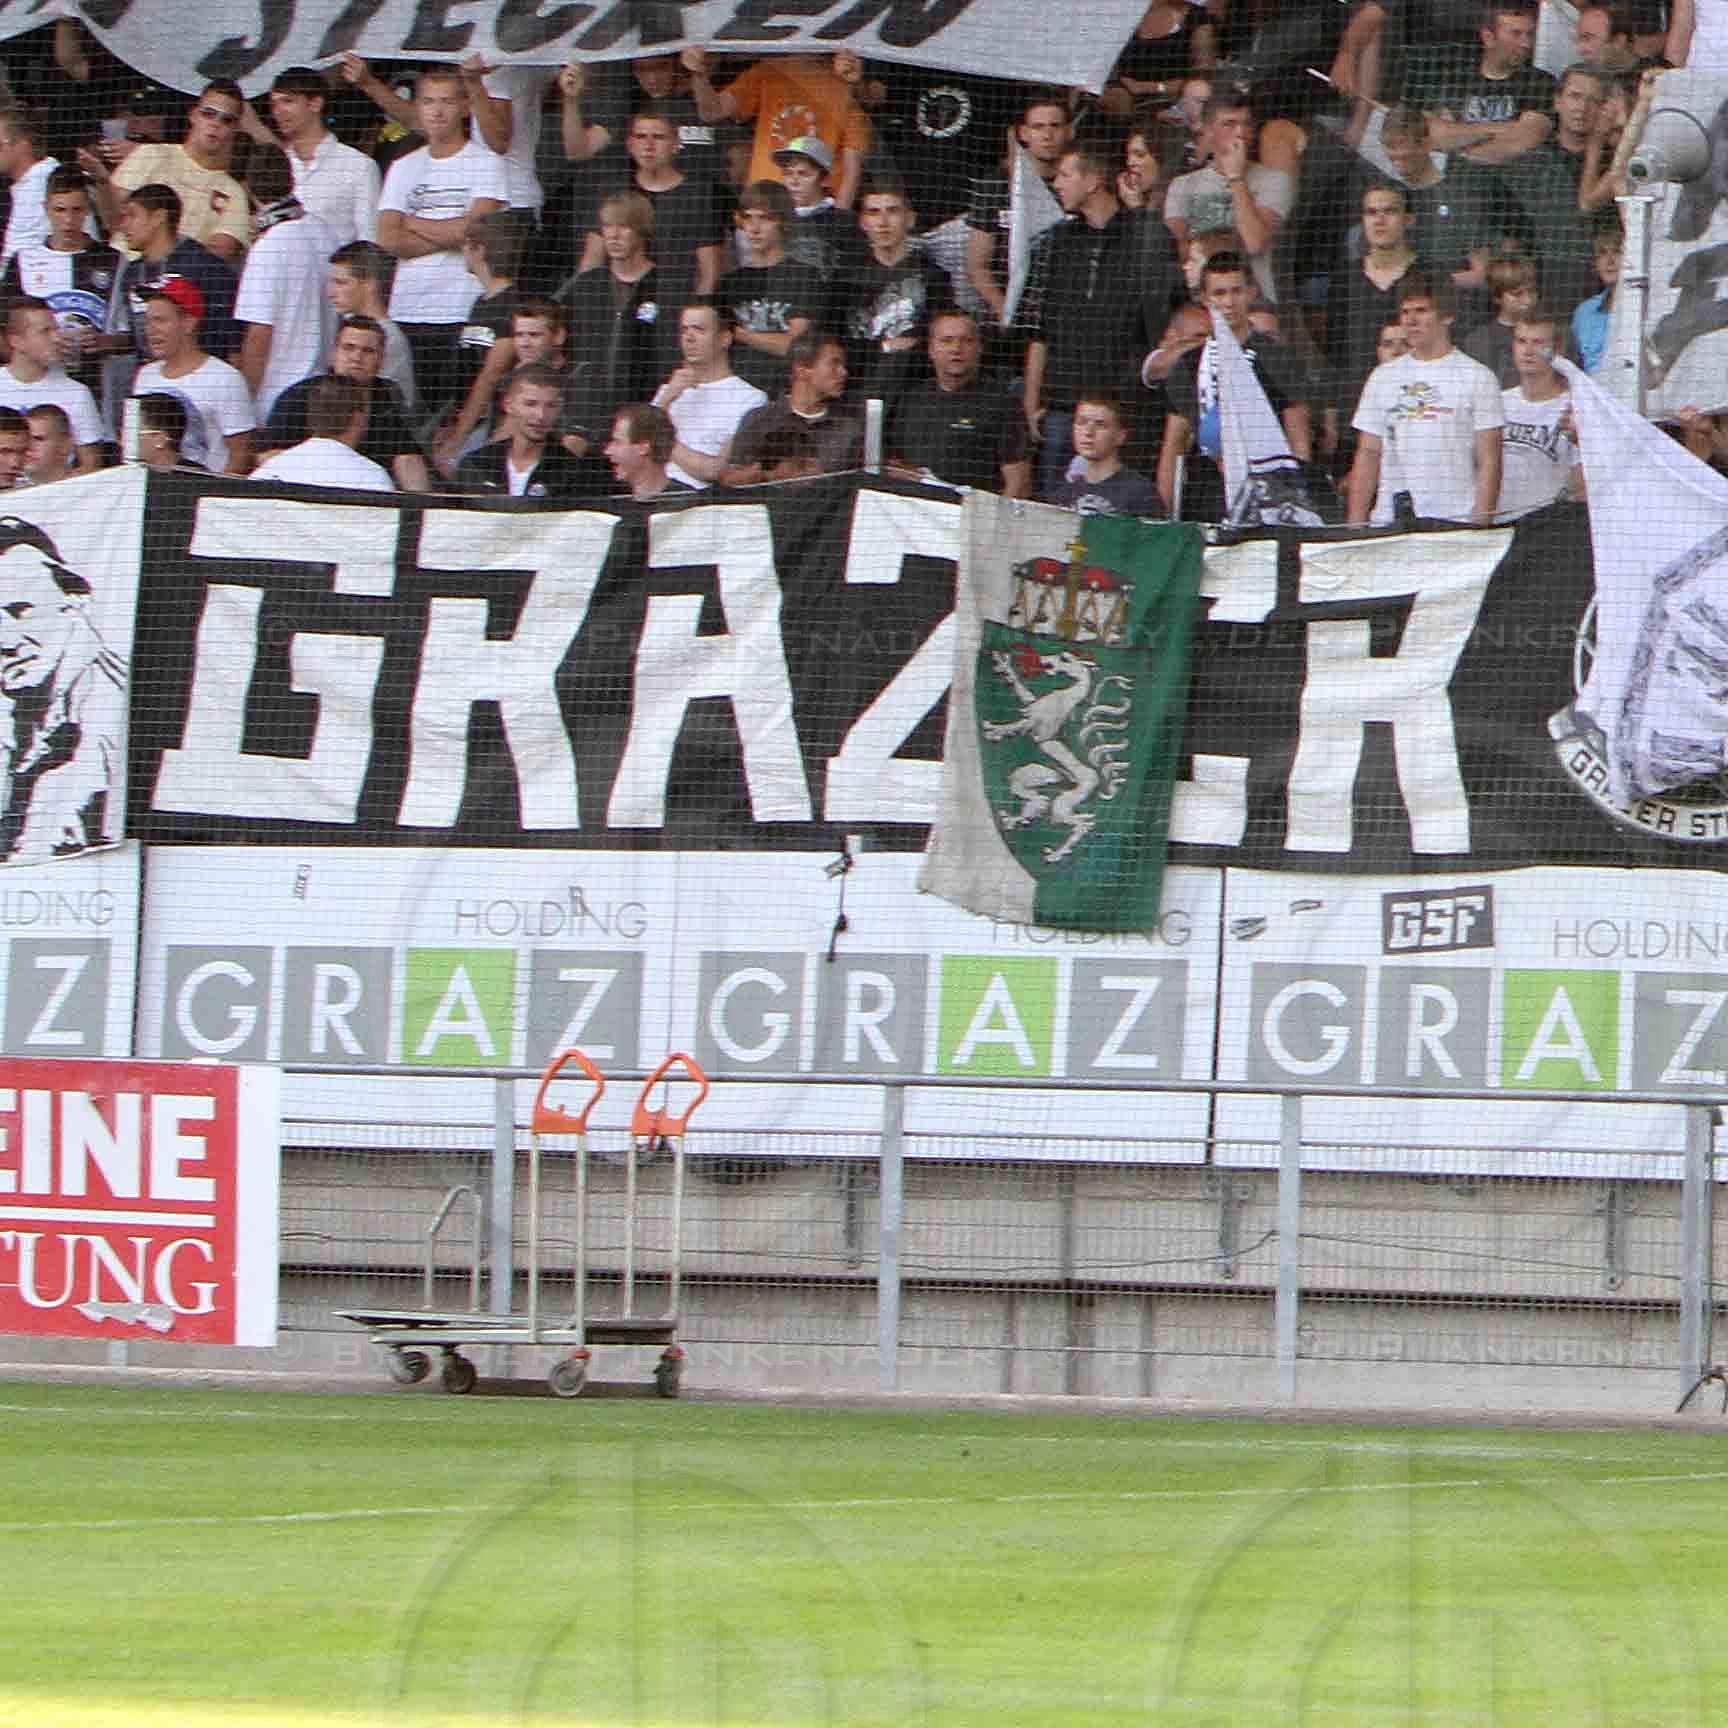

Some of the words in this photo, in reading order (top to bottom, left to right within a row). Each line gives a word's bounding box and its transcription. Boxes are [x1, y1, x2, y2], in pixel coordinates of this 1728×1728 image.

[151, 489, 1515, 856] GRAZR
[1571, 749, 1678, 835] GRER
[454, 898, 649, 941] HOLDING
[991, 908, 1193, 947] HOLDNG
[175, 959, 616, 1071] GRAZ
[708, 967, 1162, 1070] GRAZ
[1261, 978, 1728, 1085] GRAZ
[0, 1087, 217, 1202] INE
